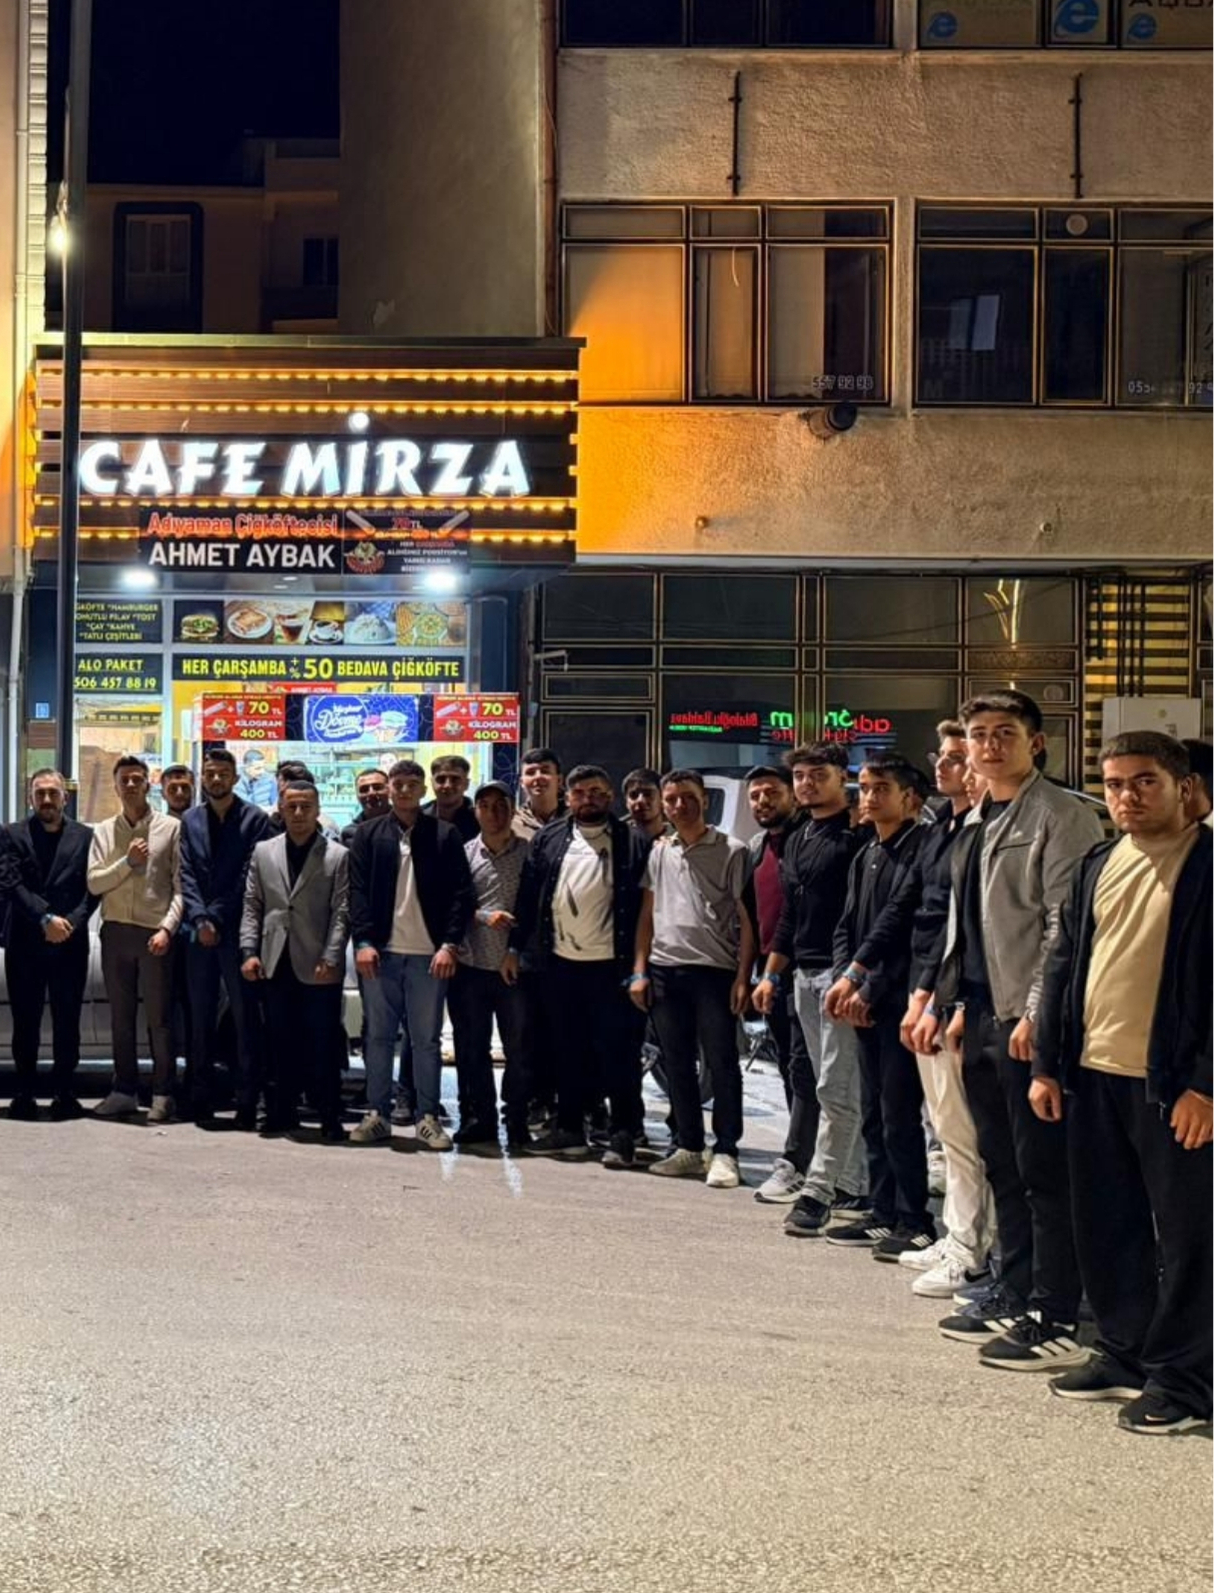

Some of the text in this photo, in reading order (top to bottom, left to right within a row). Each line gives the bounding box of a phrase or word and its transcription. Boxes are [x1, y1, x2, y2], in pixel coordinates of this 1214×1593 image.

[79, 412, 531, 498] CAFE MİRZA
[148, 542, 240, 567] AHMET
[246, 544, 335, 567] AYBAK
[78, 659, 144, 672] ALO PAKET
[182, 659, 209, 675] HER
[213, 659, 286, 679] ÇARŞAMBA
[337, 661, 388, 677] BEDAVA
[392, 657, 460, 681] ÇİĞKÖFTE
[101, 676, 122, 689] 457
[126, 676, 141, 689] 88
[248, 701, 270, 715] 70
[482, 702, 504, 716] 70
[240, 729, 265, 738] 400
[473, 730, 500, 740] 400
